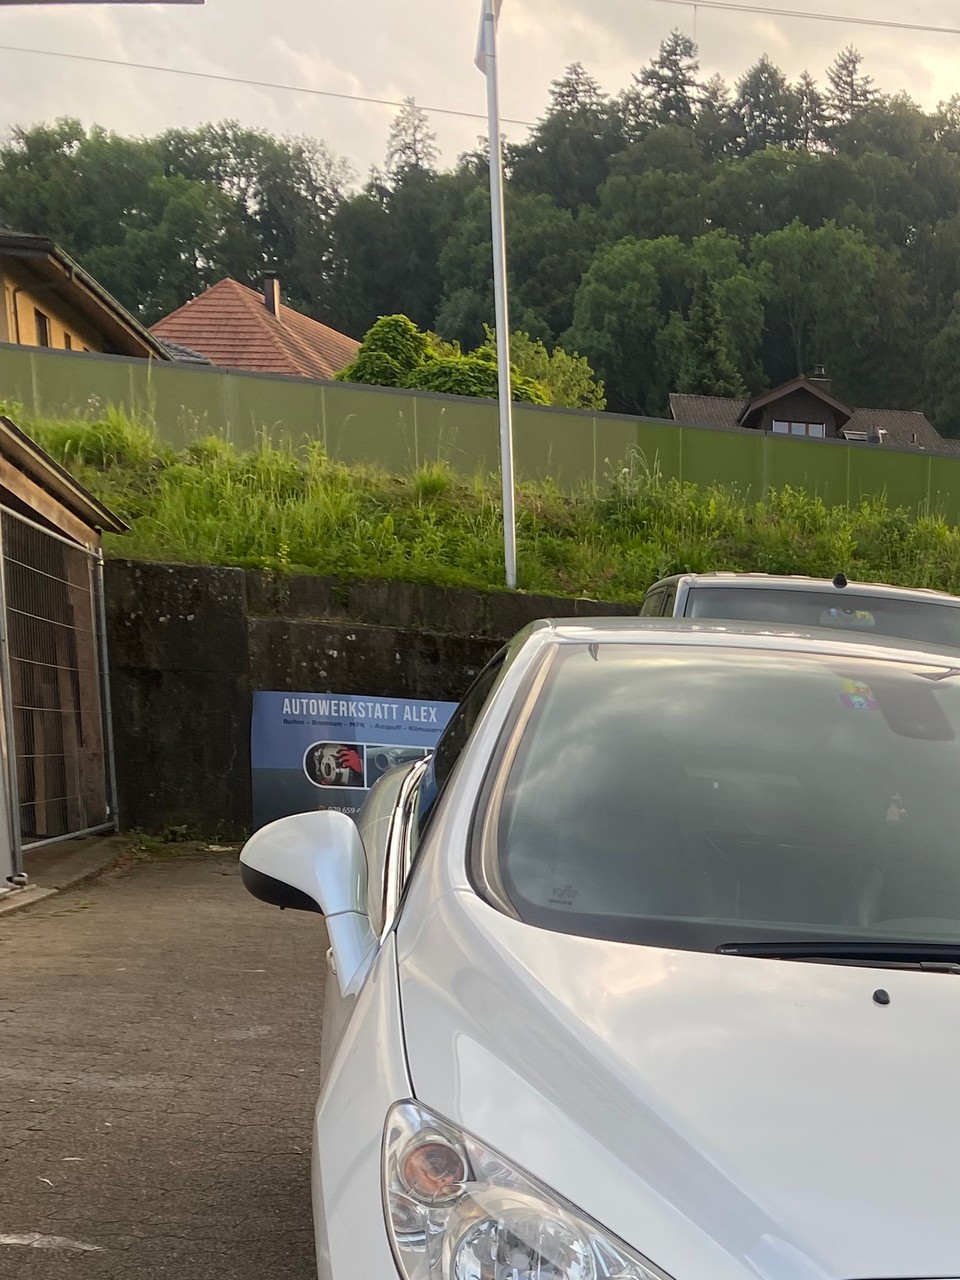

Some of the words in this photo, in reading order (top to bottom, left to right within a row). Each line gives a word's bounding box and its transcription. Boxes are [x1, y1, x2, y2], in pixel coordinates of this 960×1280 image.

[283, 698, 398, 720] AUTOWERKSTATT
[403, 705, 437, 723] ALEX
[342, 806, 355, 814] 659
